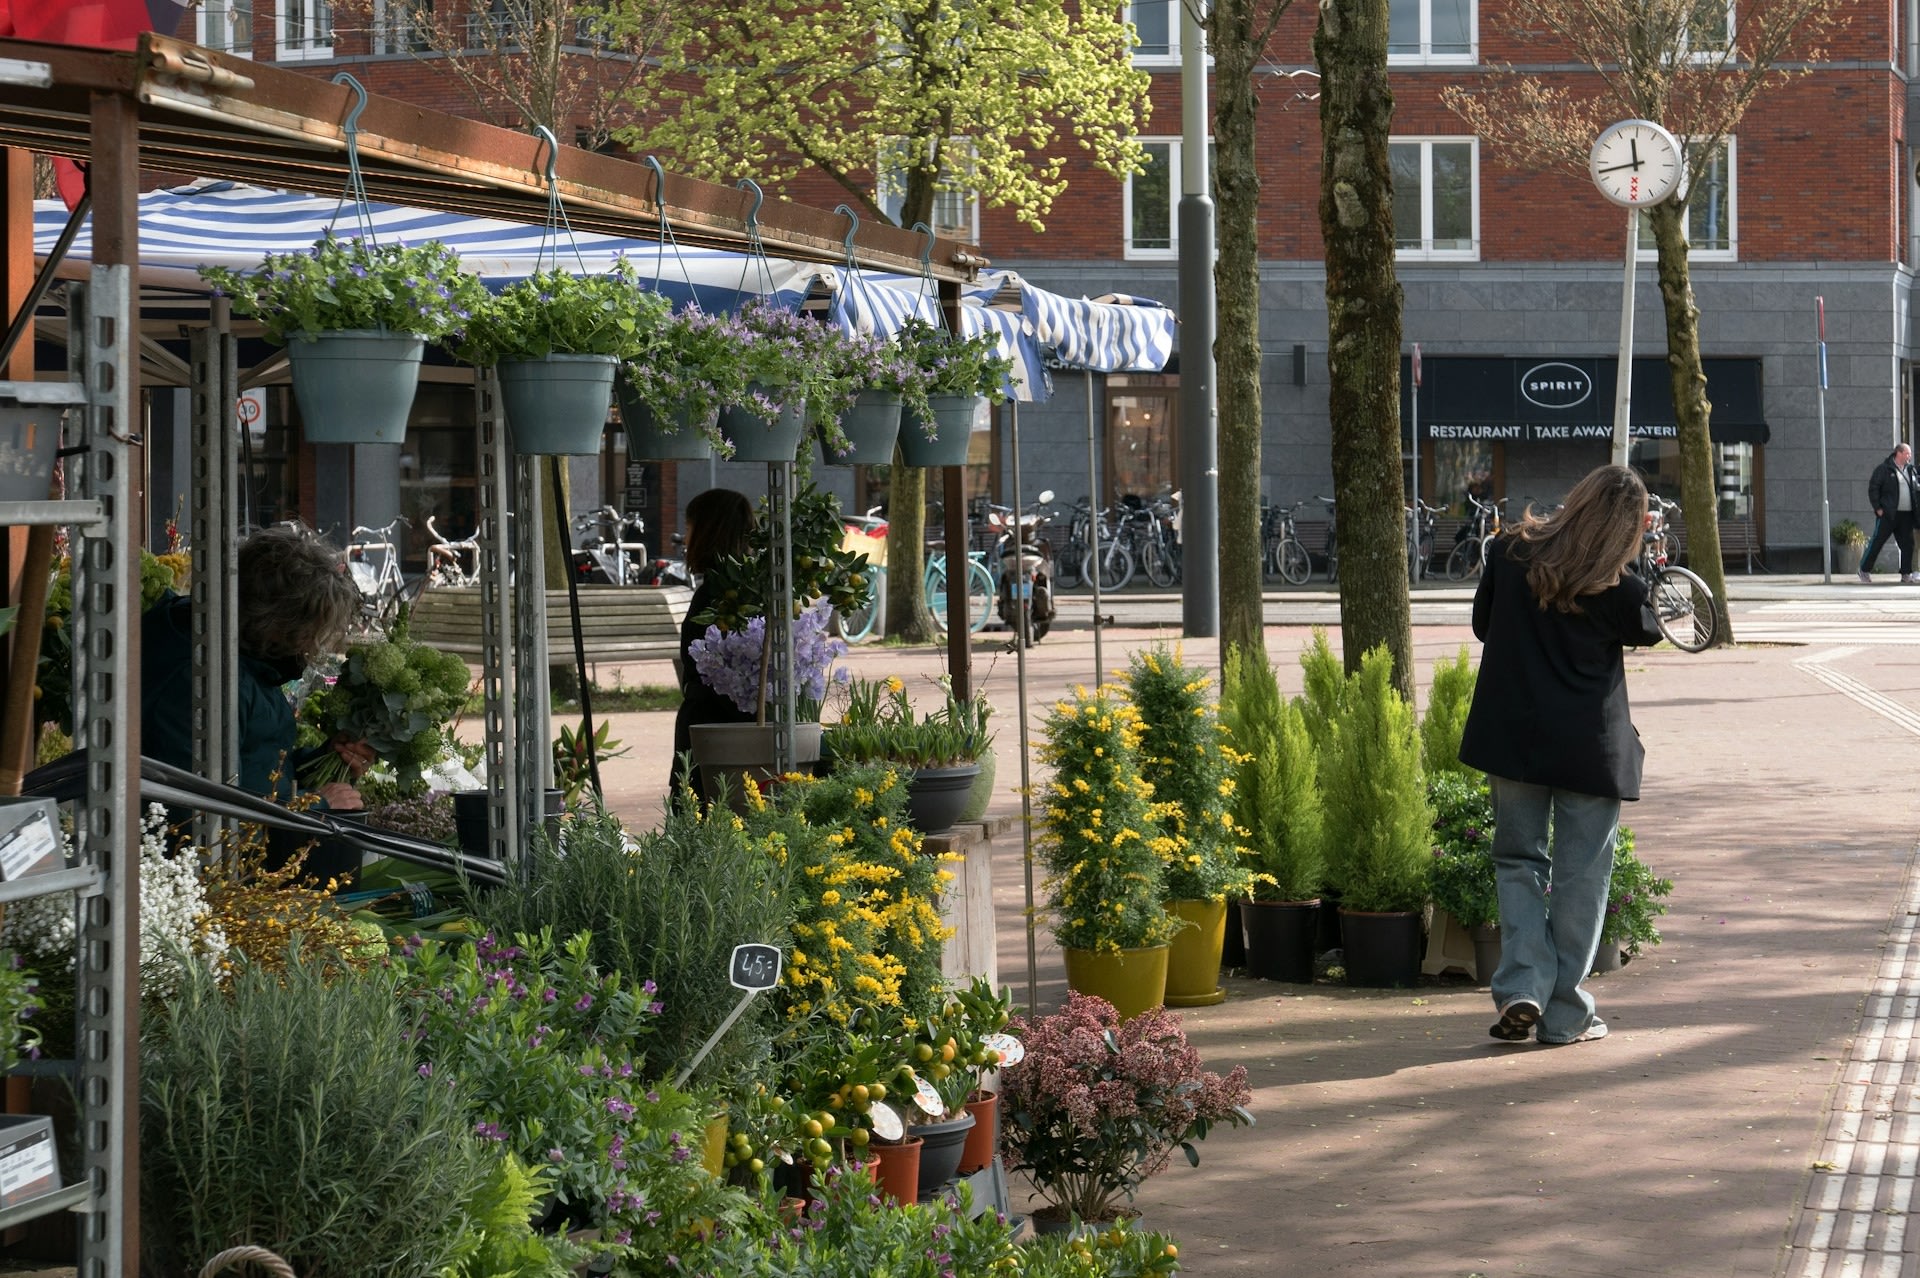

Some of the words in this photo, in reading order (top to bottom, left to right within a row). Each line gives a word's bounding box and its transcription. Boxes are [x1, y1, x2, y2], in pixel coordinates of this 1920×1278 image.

[1530, 381, 1583, 391] SPIRIT
[1429, 425, 1521, 438] RESTAURANT
[1534, 425, 1570, 438] TAKE
[1572, 425, 1612, 438] AWAY
[1629, 425, 1678, 437] CATERI
